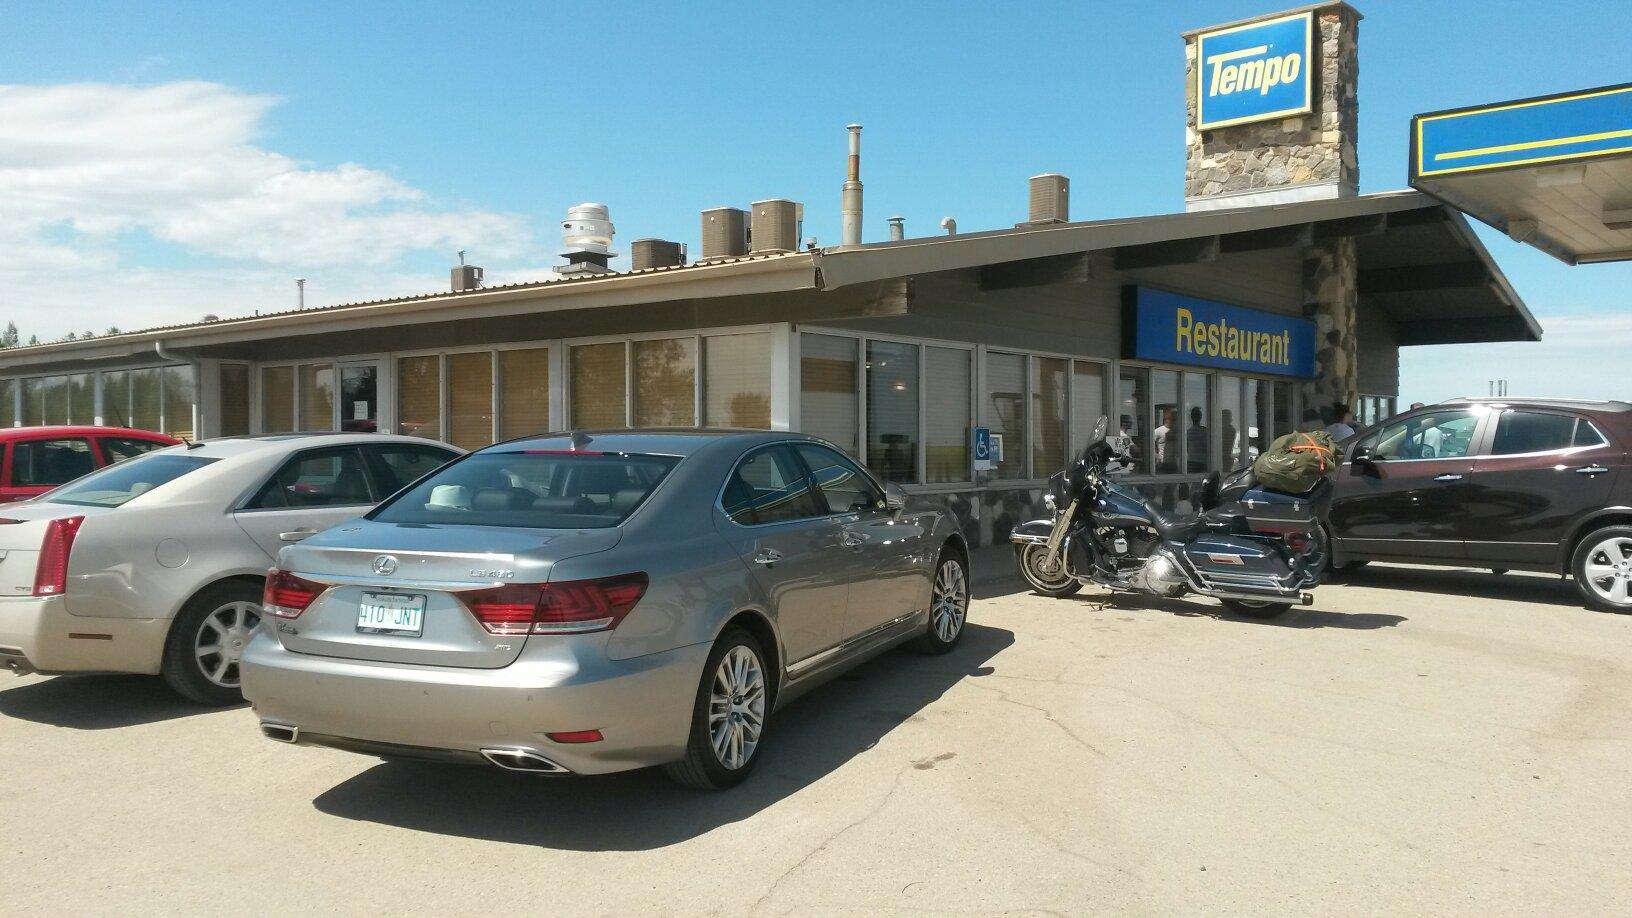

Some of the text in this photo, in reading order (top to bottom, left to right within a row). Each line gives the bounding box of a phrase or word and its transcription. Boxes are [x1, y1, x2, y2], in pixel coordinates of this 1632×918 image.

[1207, 45, 1301, 97] Tempo
[1176, 307, 1290, 366] Restaurant
[360, 604, 421, 627] 410 JNT
